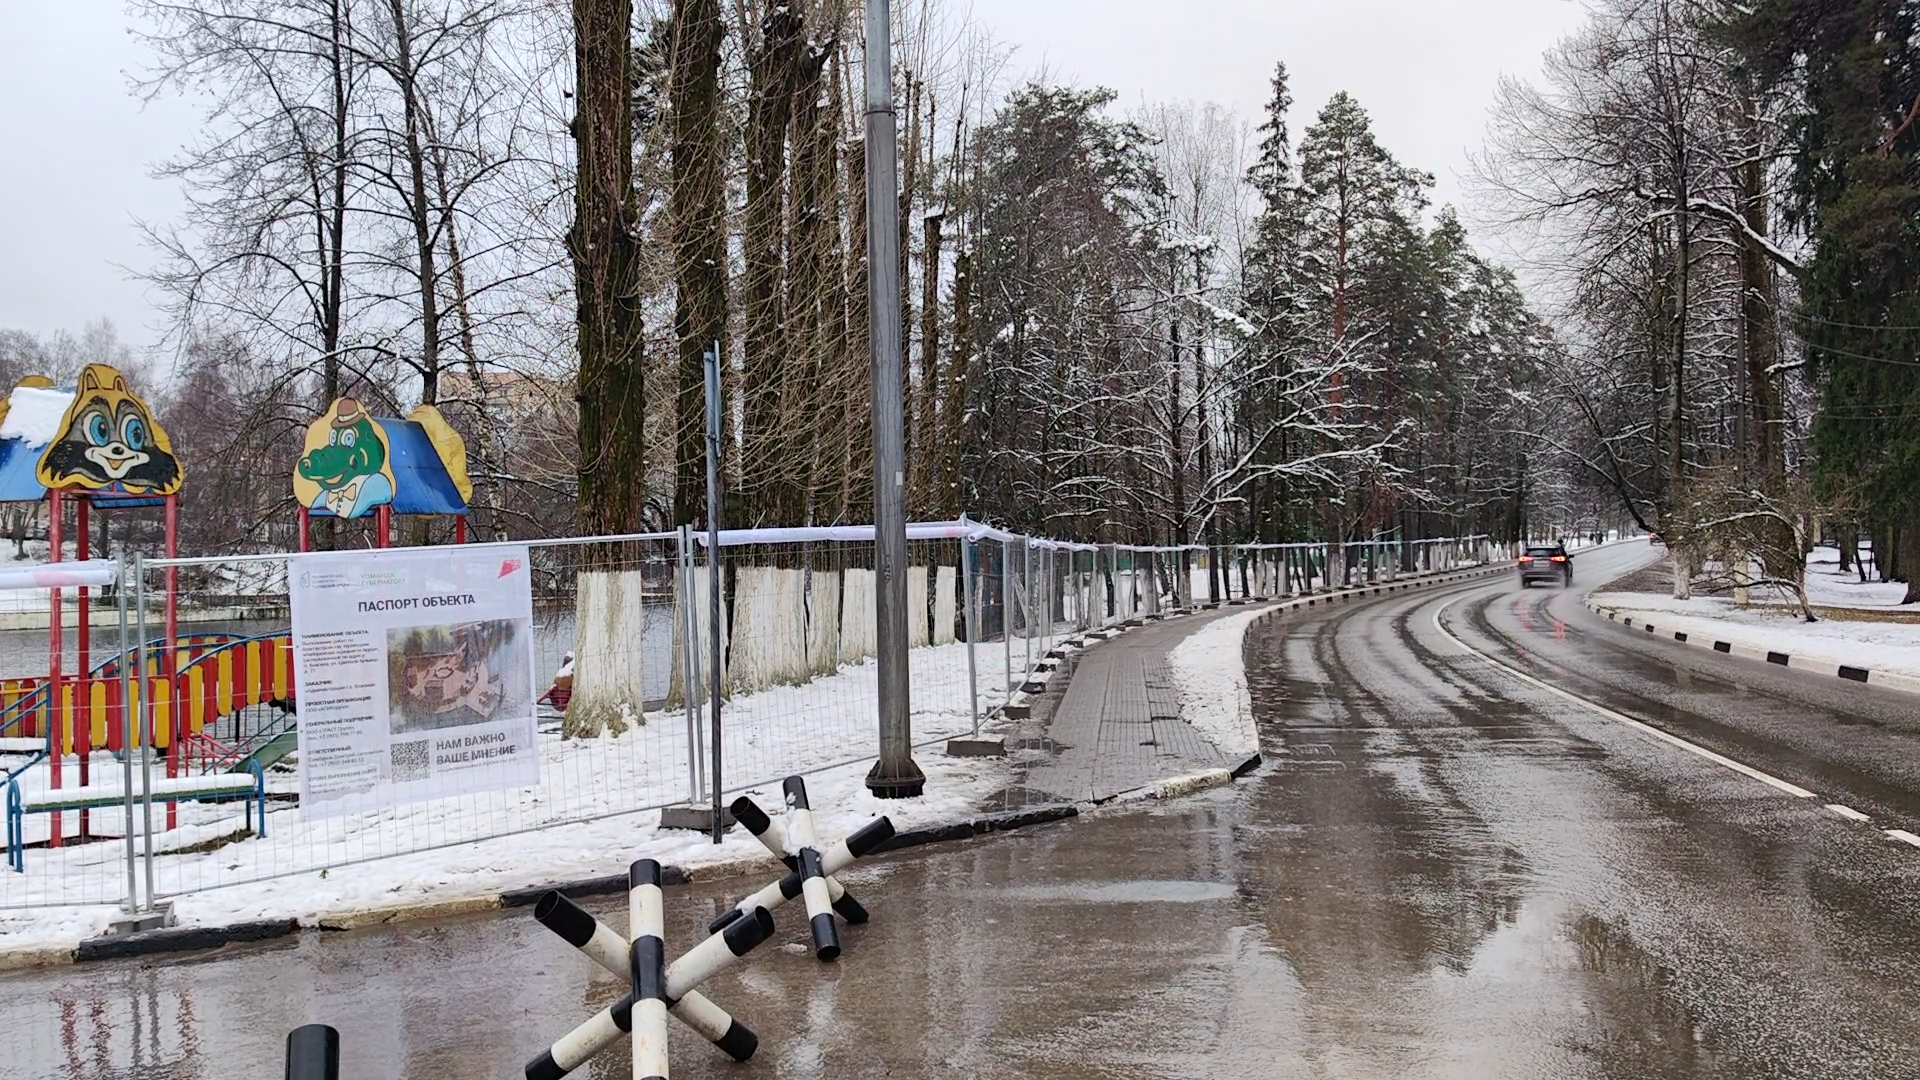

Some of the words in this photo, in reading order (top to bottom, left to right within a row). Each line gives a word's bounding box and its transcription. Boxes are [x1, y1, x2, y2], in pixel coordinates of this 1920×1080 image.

[358, 597, 420, 613] ПАСПОРТ
[422, 594, 475, 608] ОБЪЕКТА
[436, 738, 462, 751] НАМ
[464, 732, 506, 747] ВАЖНО
[436, 752, 469, 765] ВАШЕ
[471, 744, 516, 761] МНЕНИЕ
